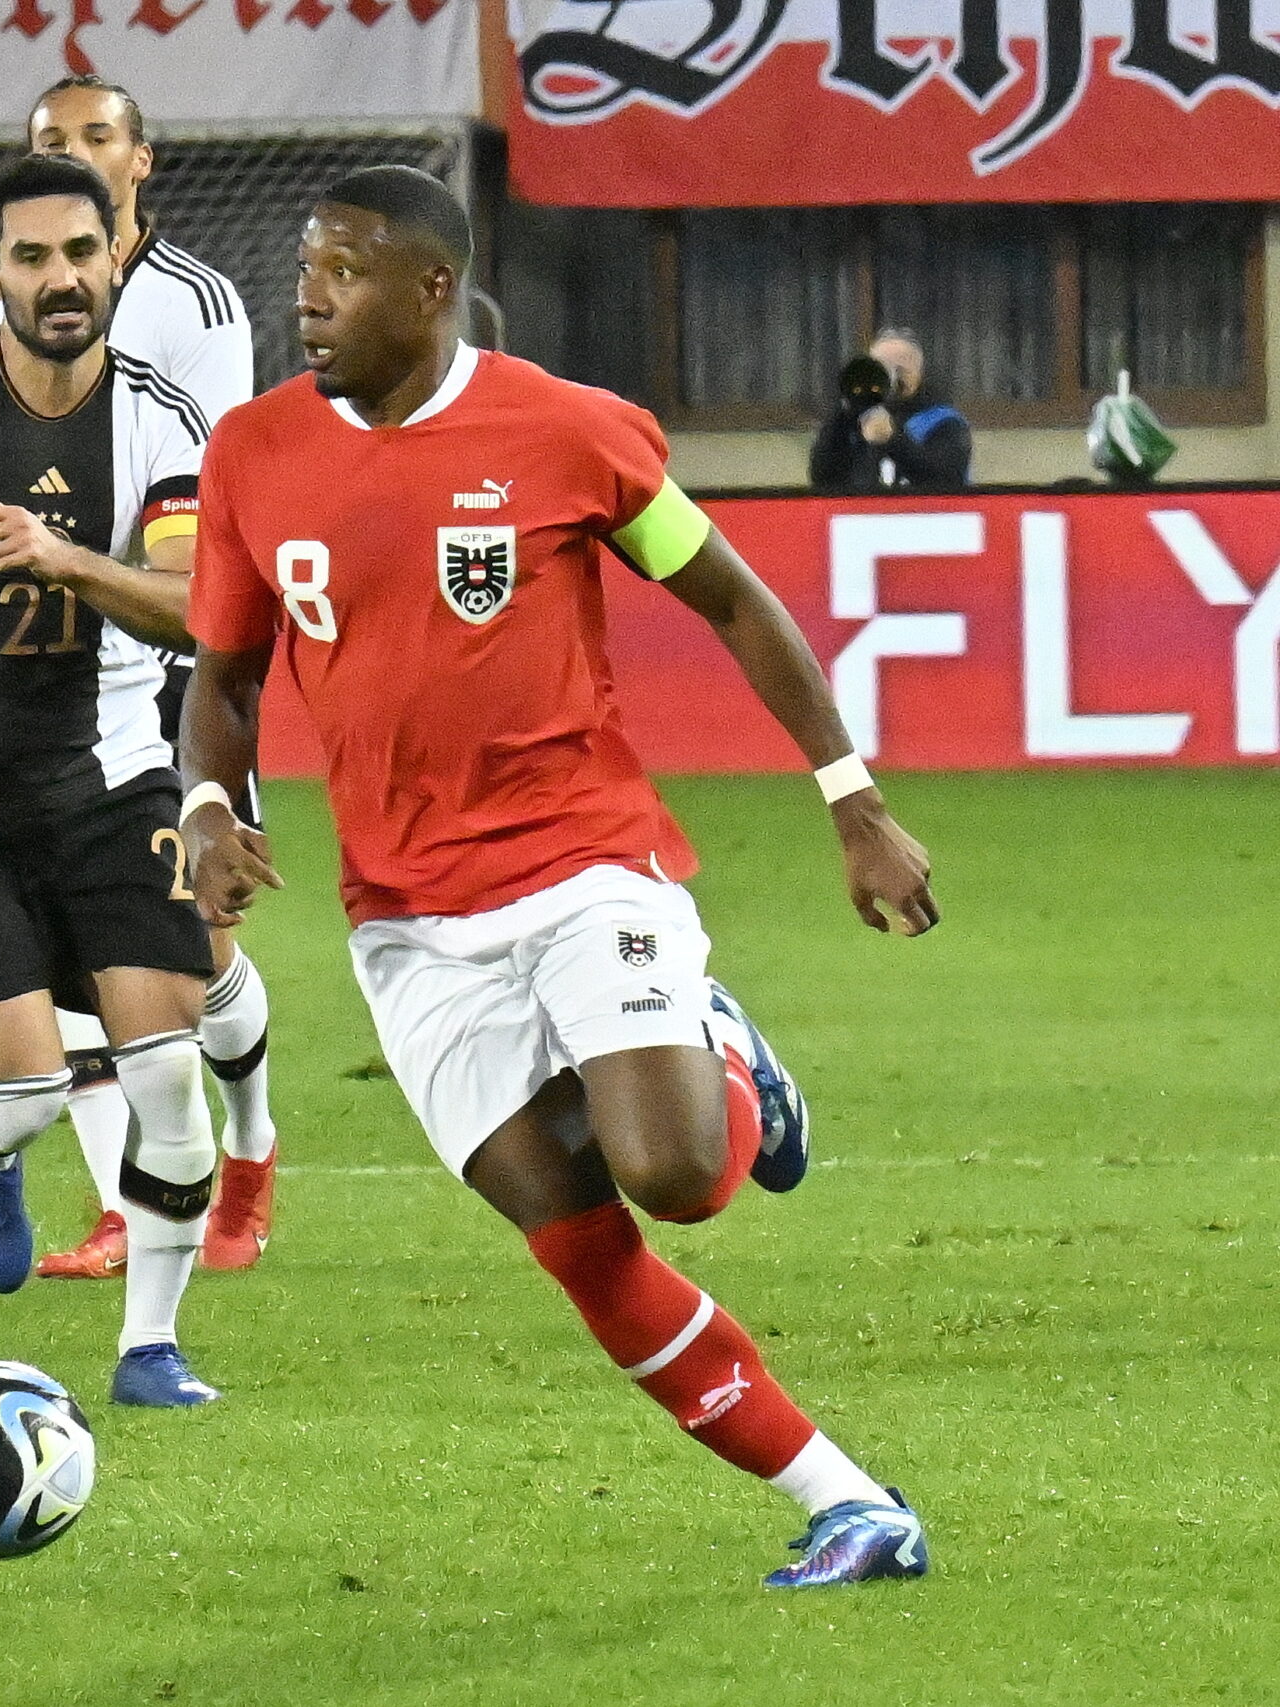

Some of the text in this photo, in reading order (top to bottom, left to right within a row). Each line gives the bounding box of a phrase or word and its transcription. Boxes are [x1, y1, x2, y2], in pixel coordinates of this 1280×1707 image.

[452, 492, 500, 509] PUMA
[276, 540, 338, 643] 8
[0, 582, 82, 656] 21
[621, 998, 667, 1014] PUMA
